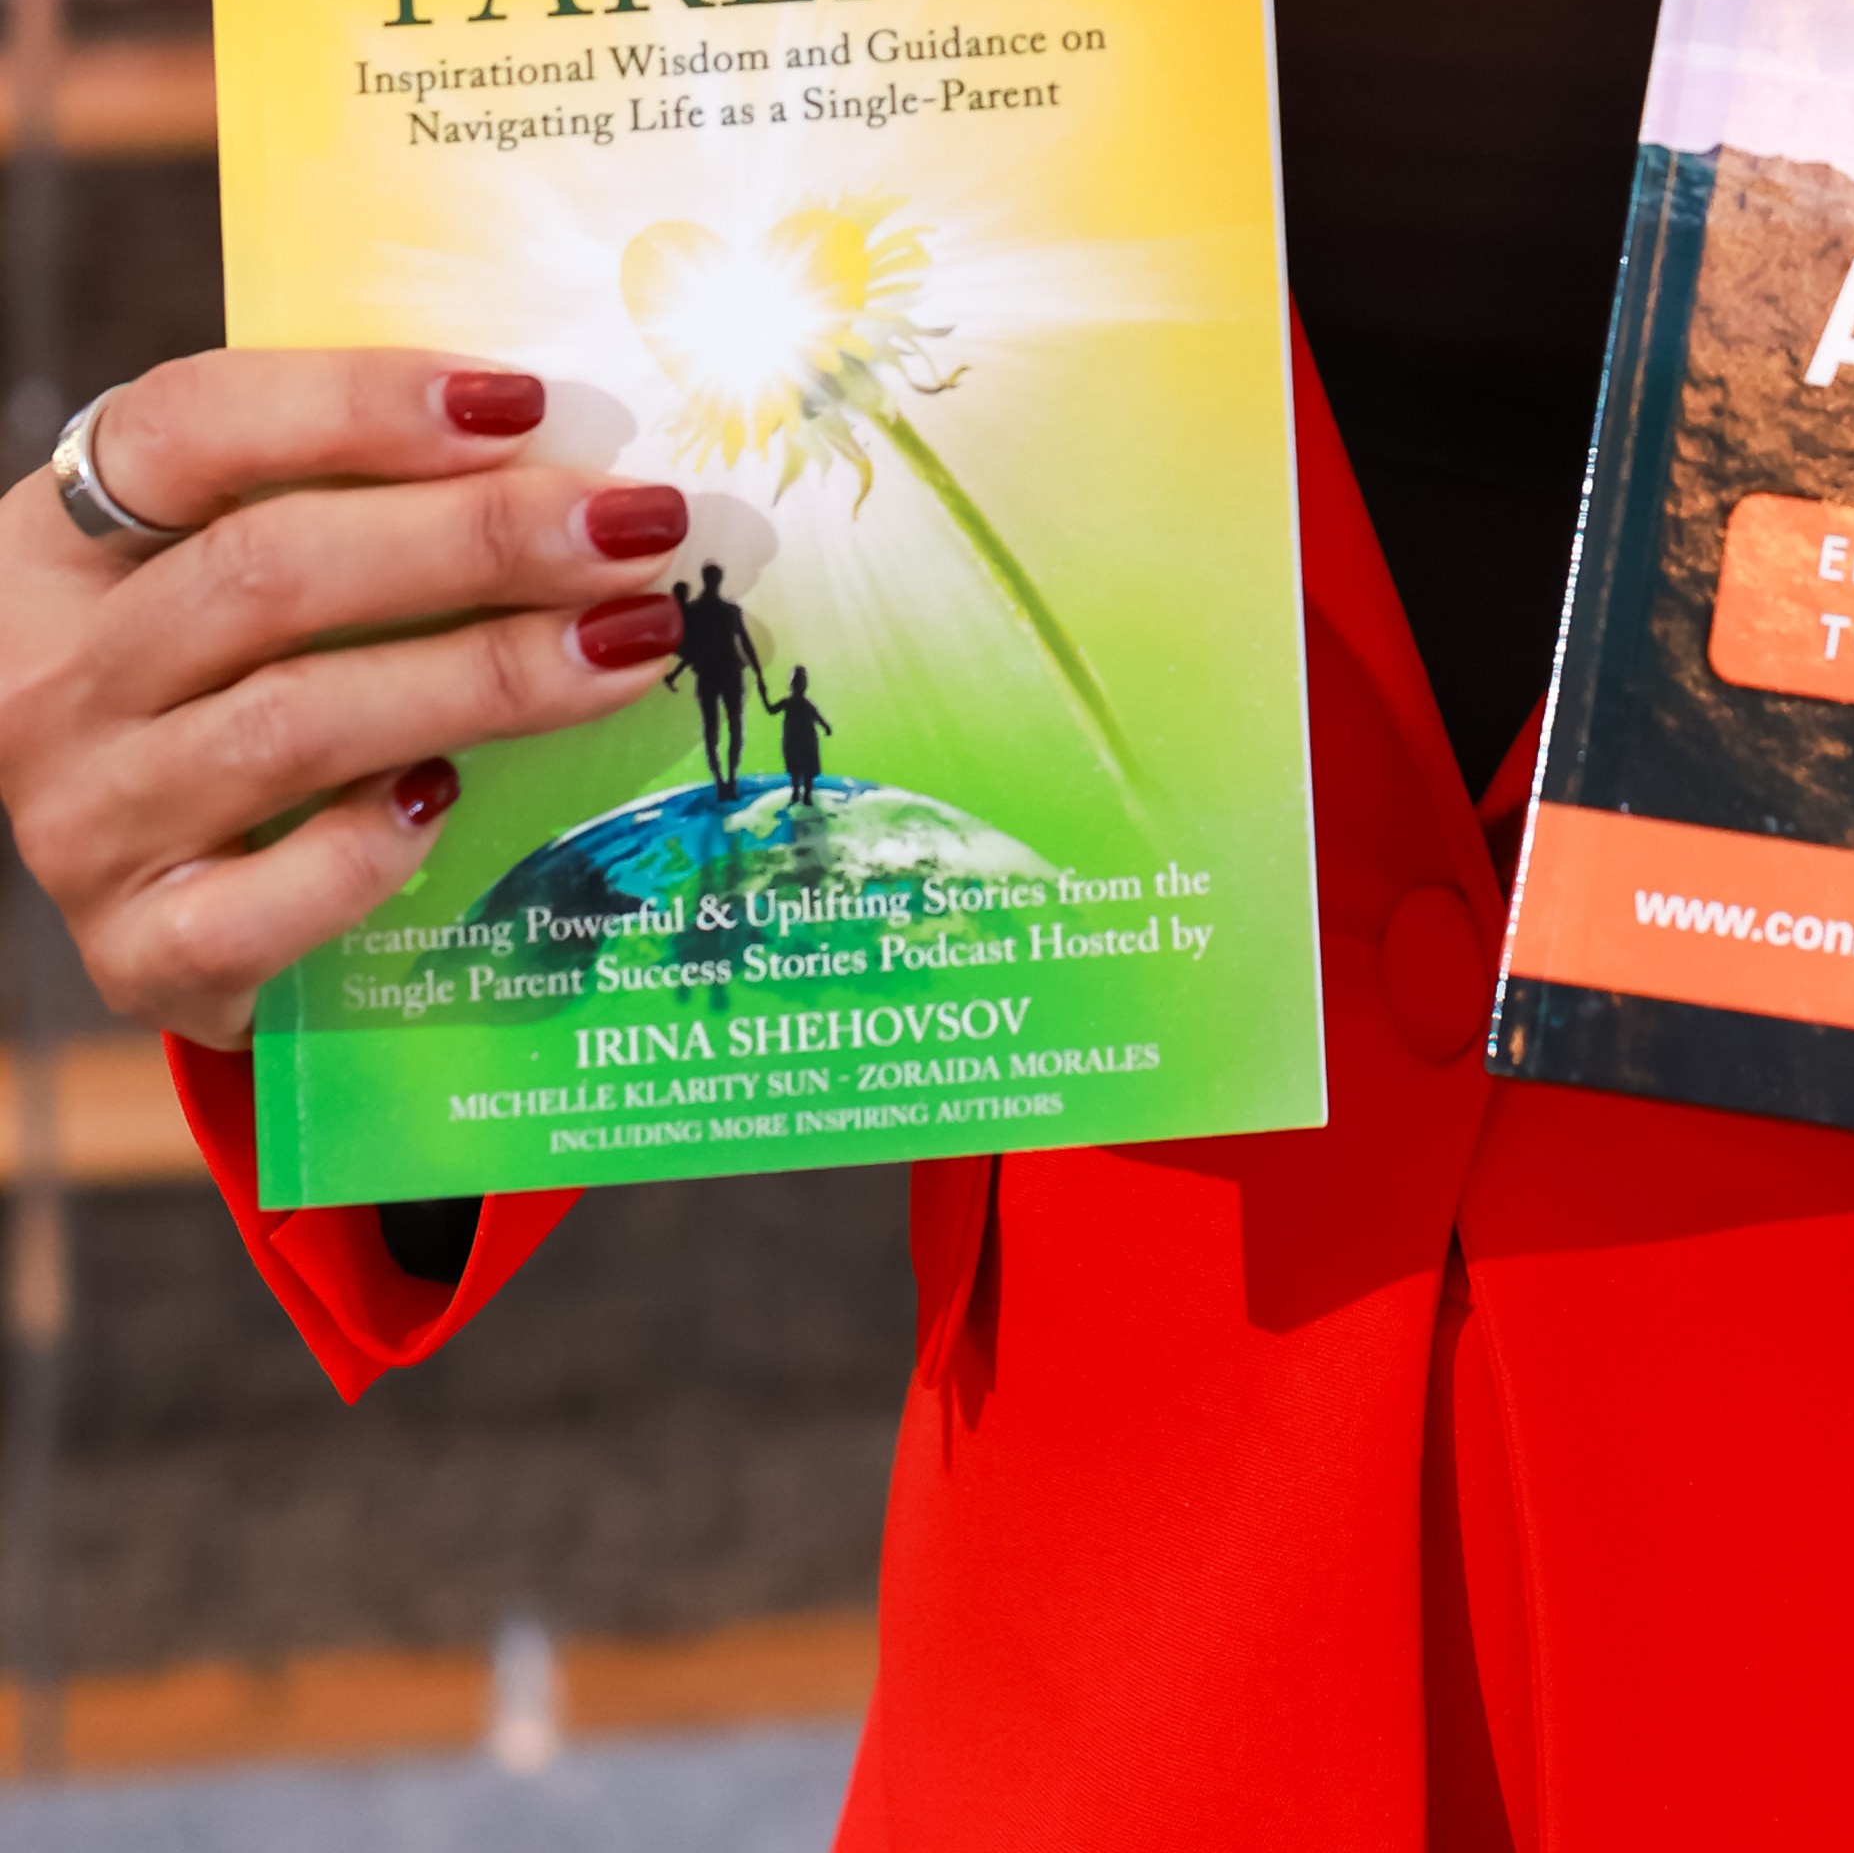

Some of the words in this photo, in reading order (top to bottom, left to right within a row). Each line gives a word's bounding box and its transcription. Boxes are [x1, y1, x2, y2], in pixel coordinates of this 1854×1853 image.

[355, 47, 598, 104] Inspirational
[608, 41, 770, 80] Wisdom
[786, 32, 851, 69] and
[867, 25, 1047, 64] Guidance
[1061, 28, 1107, 52] on
[407, 107, 615, 151] Navigating
[629, 94, 706, 133] Life
[720, 103, 755, 126] as
[770, 101, 788, 123] a
[802, 79, 1062, 129] Single-Parent
[342, 915, 516, 958] Featuring
[525, 894, 685, 945] Powerful
[696, 892, 740, 930] &
[744, 881, 912, 936] Uplifting
[921, 875, 1046, 915] Stories
[1057, 868, 1143, 906] from
[1154, 860, 1211, 899] the
[341, 969, 455, 1019] Single
[467, 964, 584, 1004] Parent
[595, 954, 733, 993] Success
[743, 942, 868, 982] Stories
[878, 932, 1018, 972] Podcast
[1029, 915, 1160, 962] Hosted
[1171, 913, 1214, 960] by
[575, 1020, 715, 1069] IRINA
[728, 997, 1032, 1057] SHEHOVSOV
[449, 1084, 617, 1122] MICHELLE
[624, 1073, 760, 1109] KLARITY
[767, 1068, 830, 1097] SUN
[857, 1056, 1001, 1092] ZORAIDA
[1009, 1043, 1160, 1082] MORALES
[550, 1121, 702, 1154] INCLUDING
[709, 1113, 788, 1142] MORE
[795, 1104, 928, 1137] INSPIRING
[935, 1093, 1063, 1125] AUTHORS
